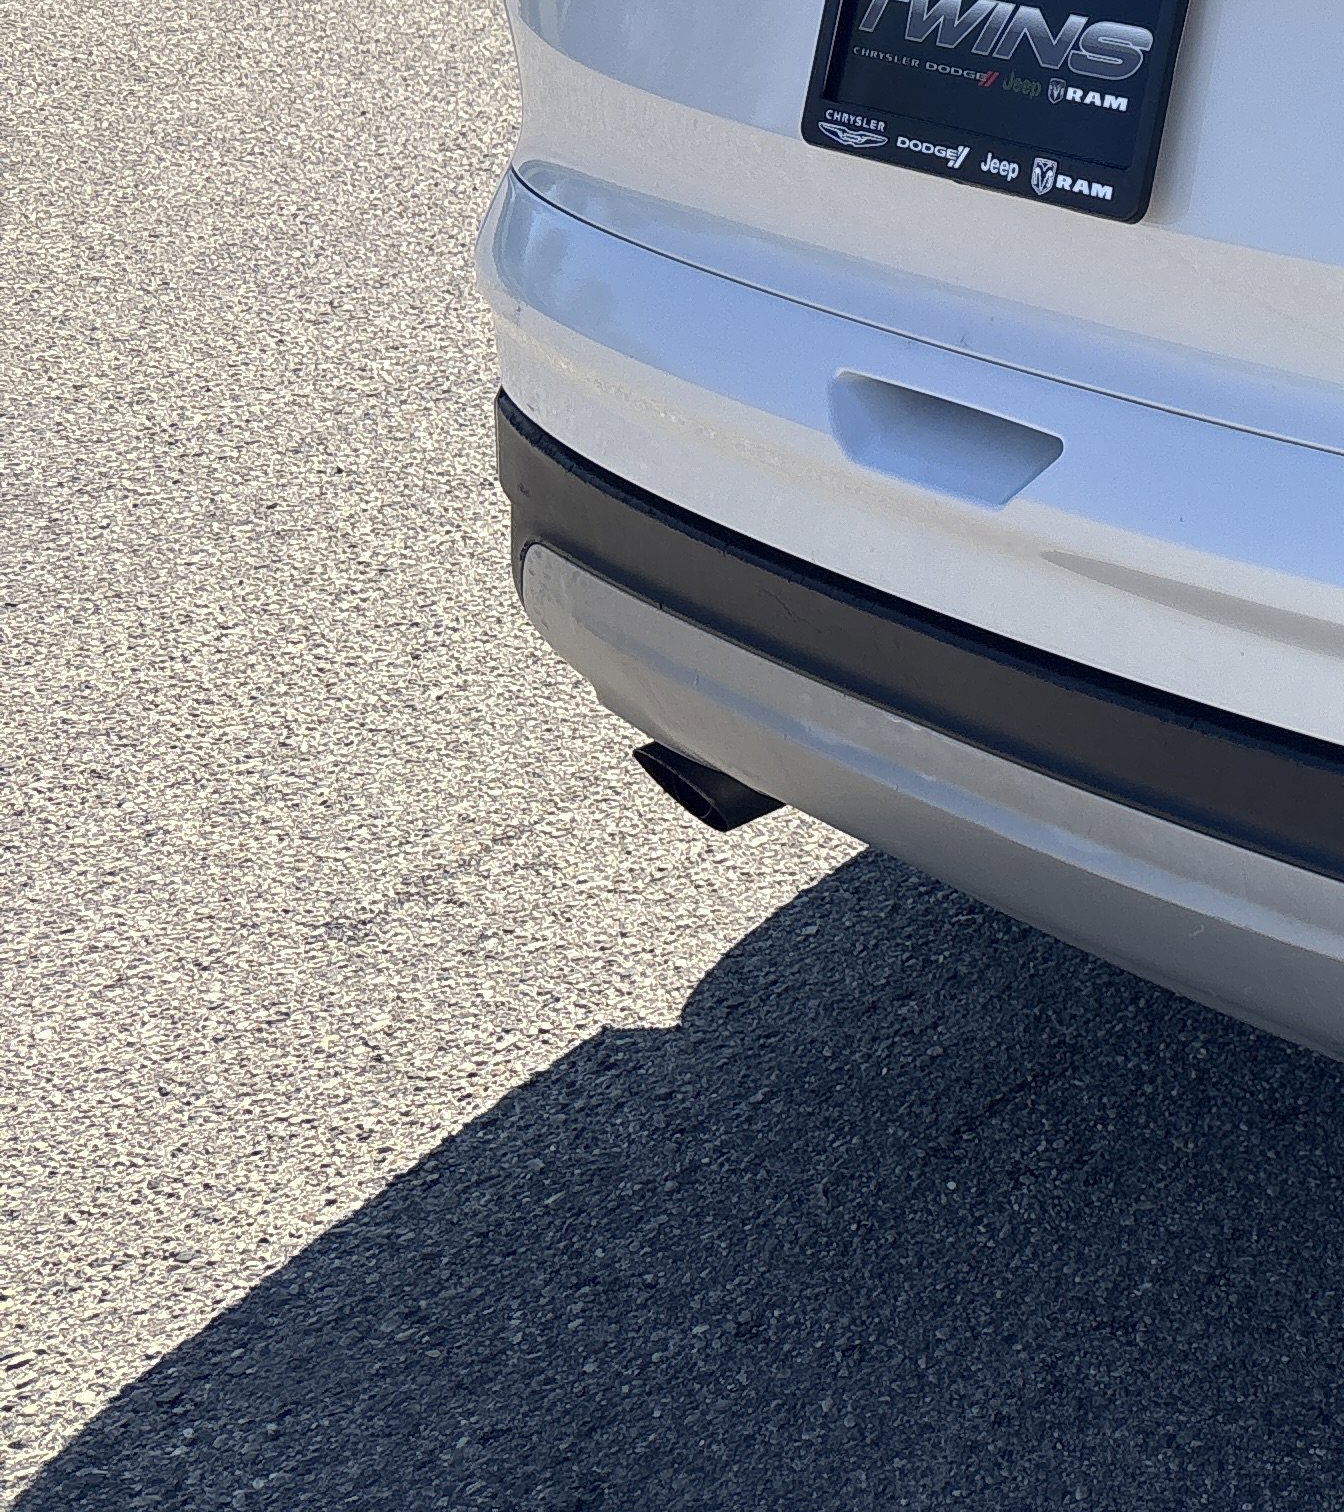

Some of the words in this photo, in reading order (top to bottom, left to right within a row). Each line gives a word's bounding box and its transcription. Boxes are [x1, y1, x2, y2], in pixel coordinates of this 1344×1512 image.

[853, 46, 920, 68] CHRYSLER
[925, 61, 987, 82] DODGE
[1002, 71, 1042, 99] Jeep
[1065, 86, 1129, 112] RAM
[825, 109, 886, 132] CHRYSLER
[896, 136, 957, 160] DODGE
[980, 152, 1019, 181] Jeep
[1055, 174, 1113, 201] RAM
